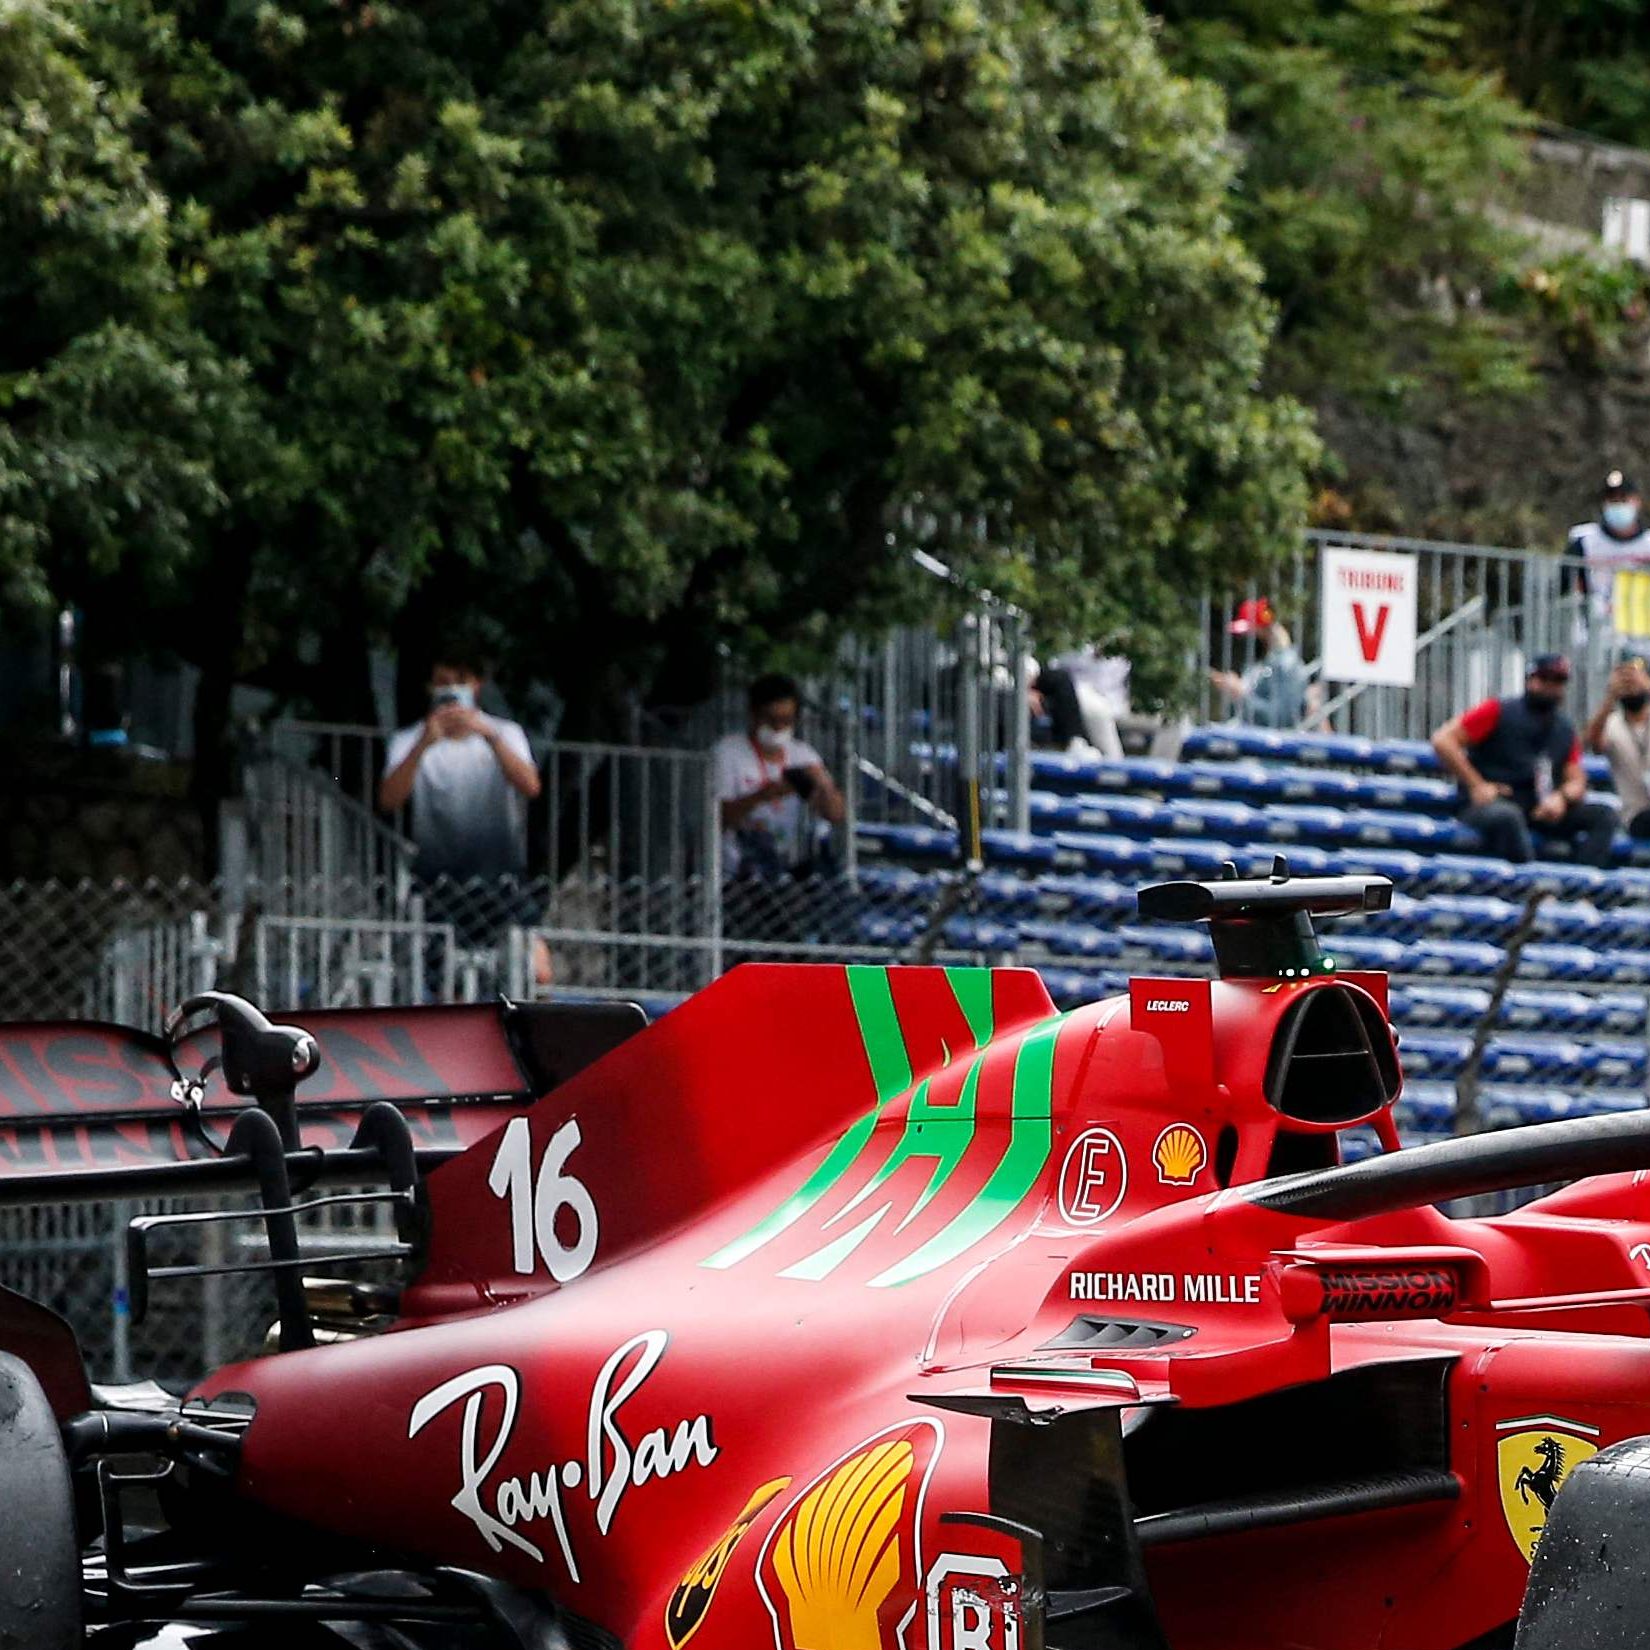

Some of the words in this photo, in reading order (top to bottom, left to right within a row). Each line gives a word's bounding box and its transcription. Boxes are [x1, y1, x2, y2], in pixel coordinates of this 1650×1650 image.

[1352, 602, 1389, 662] V
[1147, 1001, 1190, 1012] LECLERC
[488, 1115, 600, 1283] 16
[1069, 1272, 1175, 1301] RICHARD
[1184, 1275, 1261, 1303] MILLE
[1320, 1272, 1455, 1292] MISSION
[1320, 1292, 1455, 1312] WINNOW
